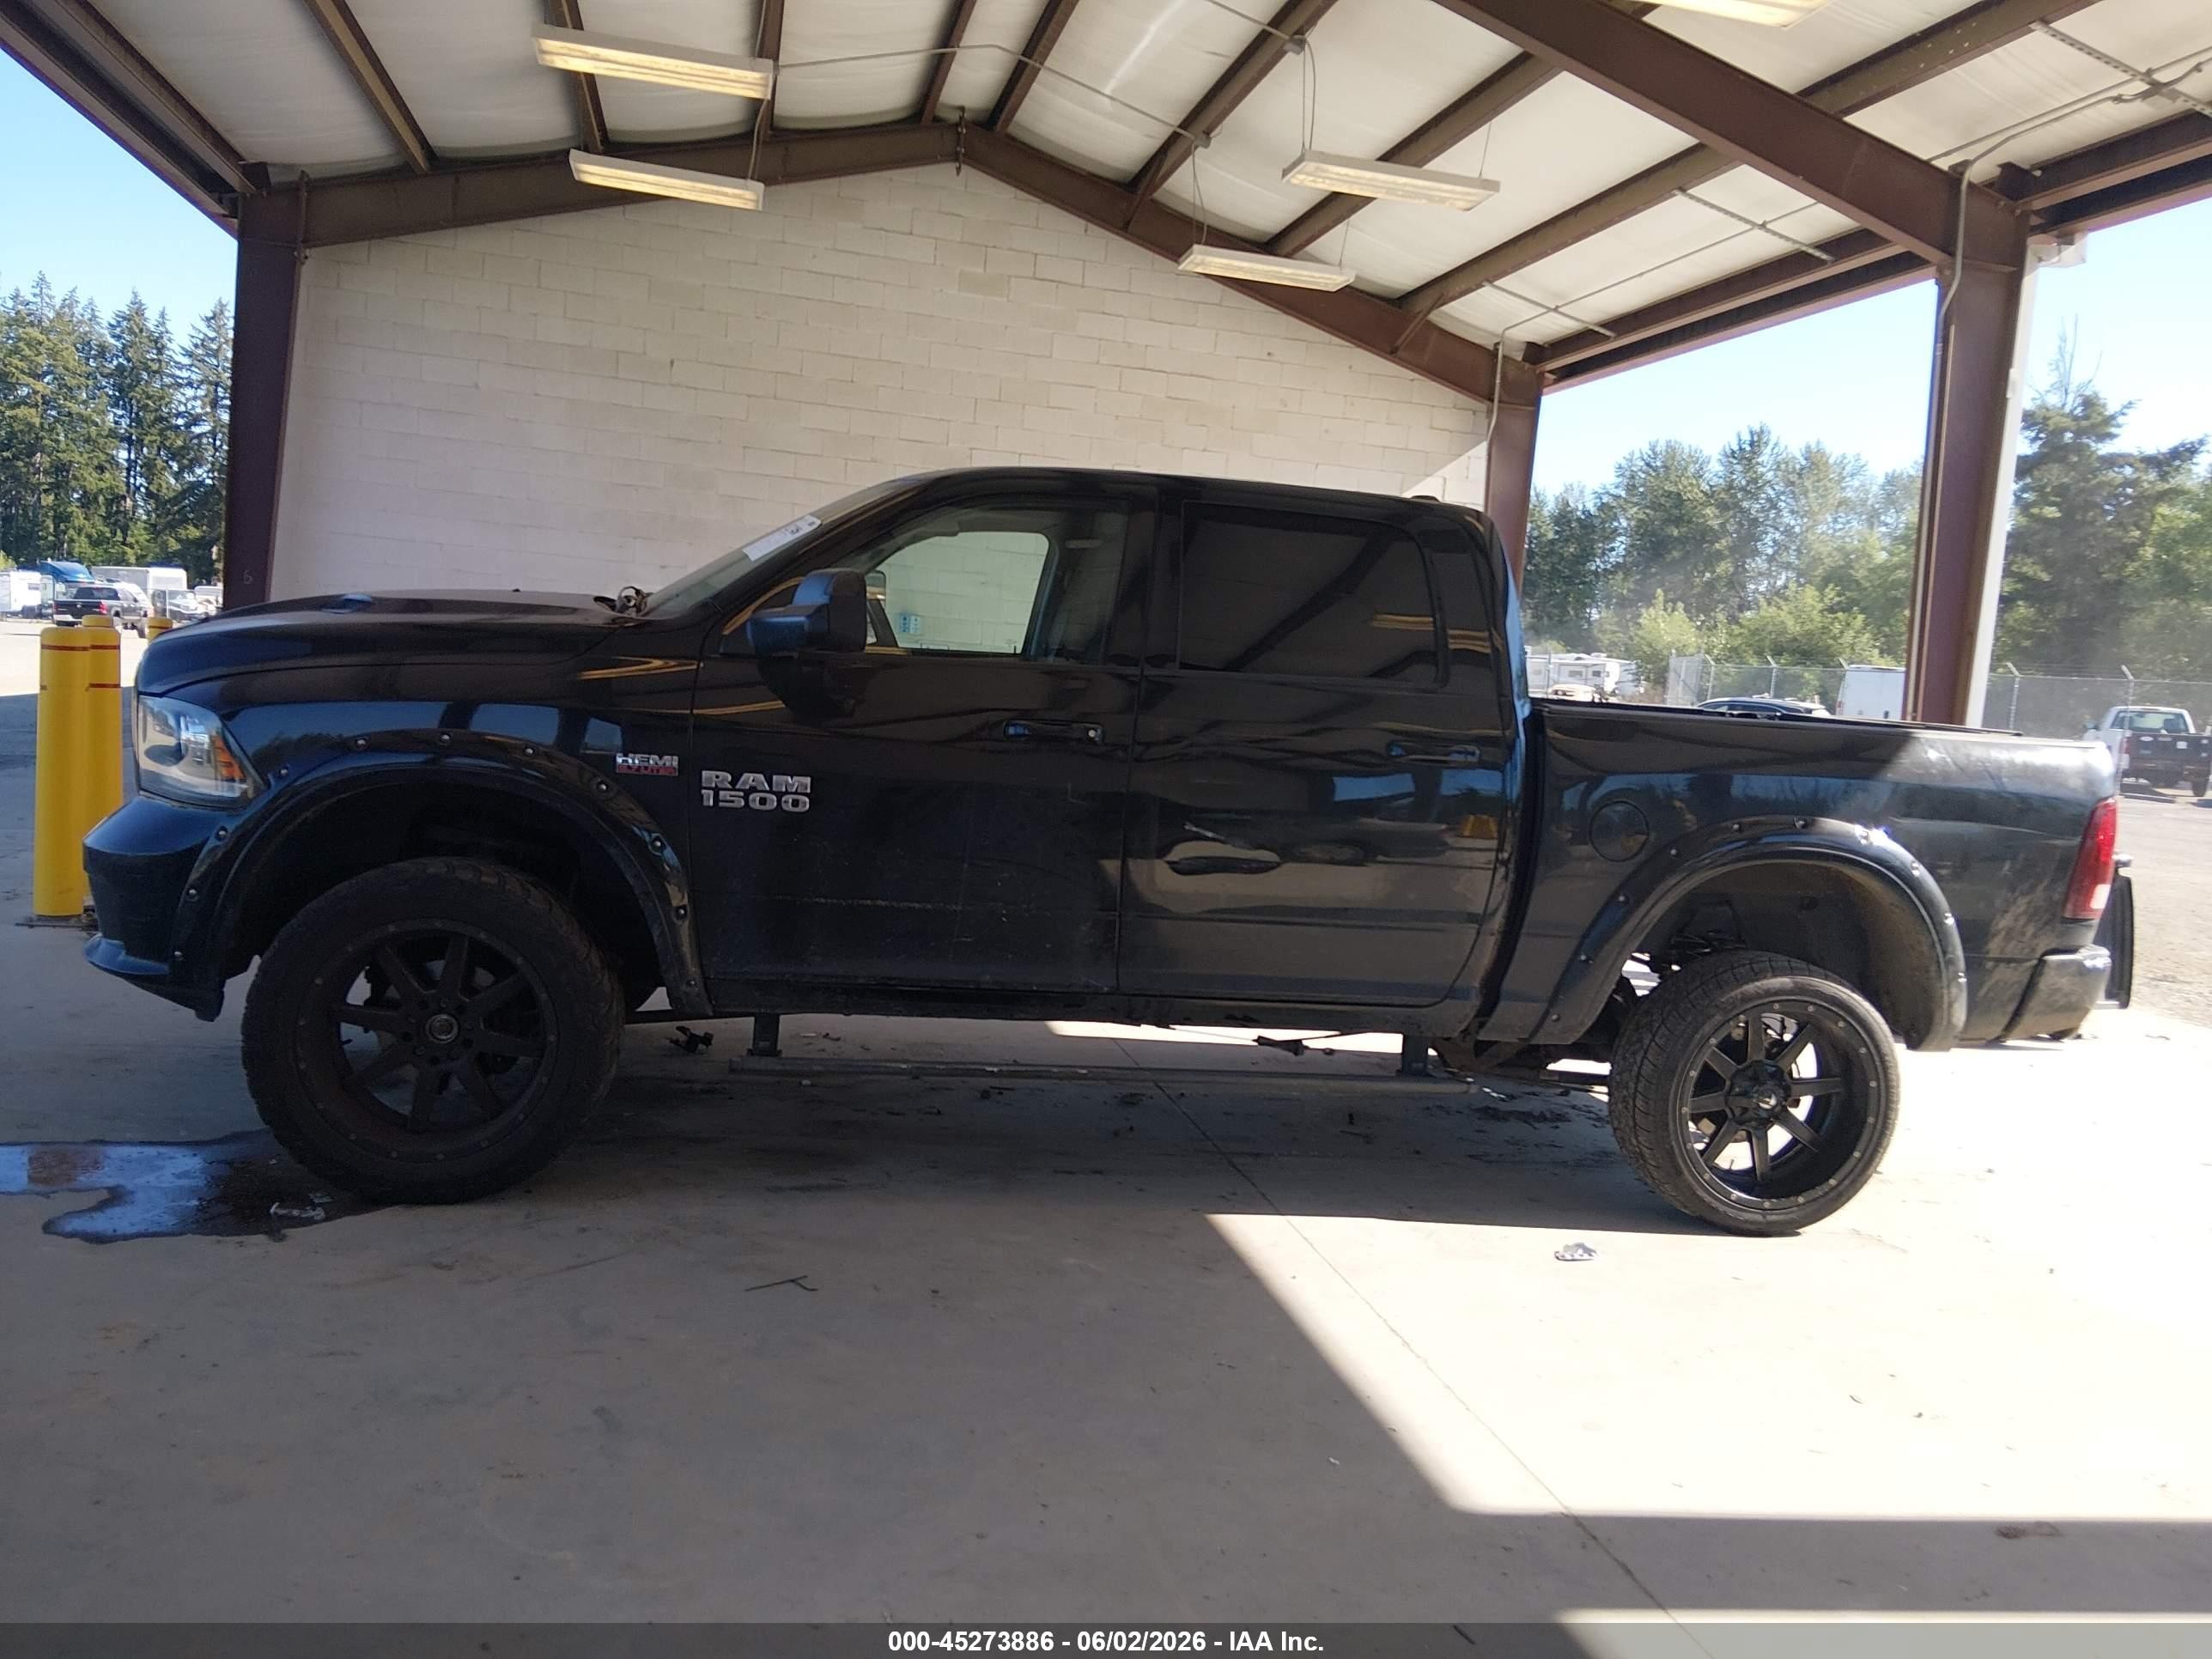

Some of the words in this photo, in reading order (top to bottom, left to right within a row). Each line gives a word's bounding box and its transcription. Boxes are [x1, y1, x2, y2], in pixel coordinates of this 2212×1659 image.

[616, 753, 679, 767] HEMI
[702, 770, 811, 793] RAM
[701, 790, 810, 812] 1500
